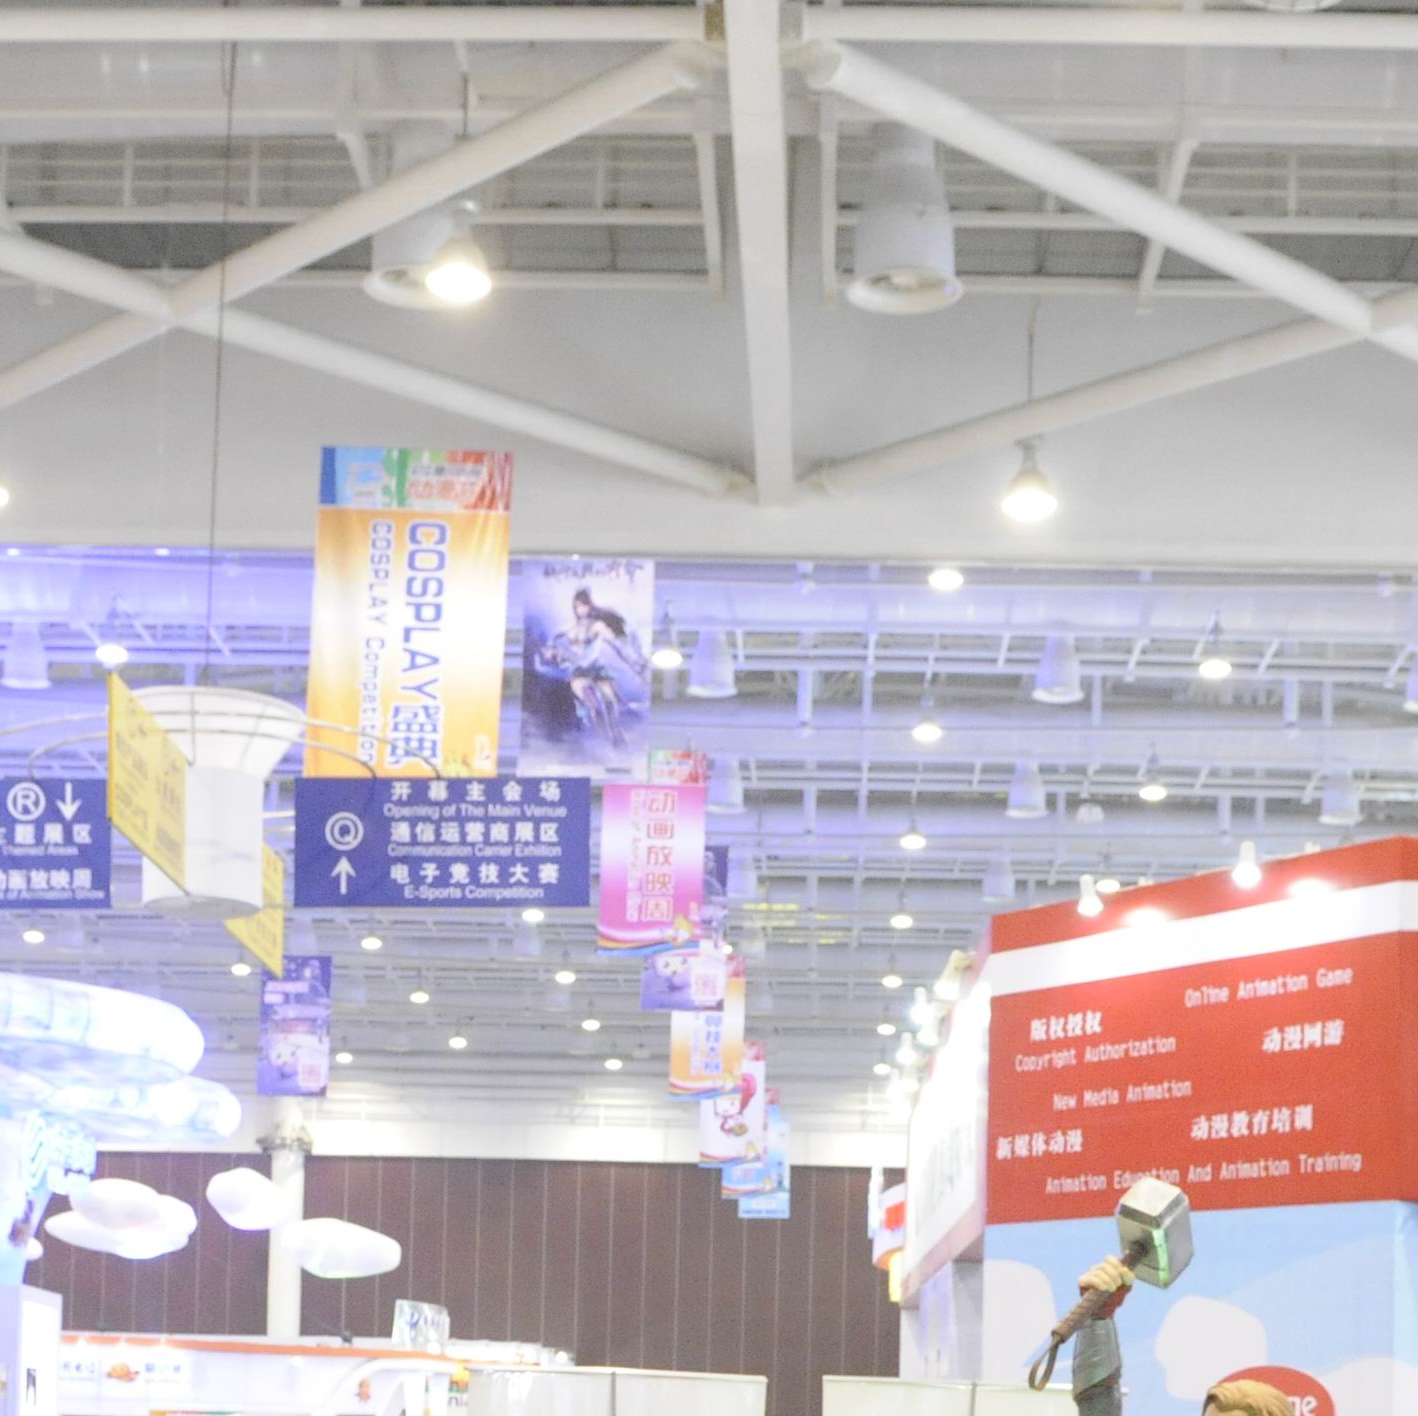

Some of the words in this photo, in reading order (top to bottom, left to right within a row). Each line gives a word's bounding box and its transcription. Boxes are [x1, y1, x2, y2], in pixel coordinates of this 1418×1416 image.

[368, 520, 393, 626] COSPLAY
[390, 780, 561, 802] 开幕主会场
[383, 803, 440, 819] Opening
[442, 803, 458, 817] of
[459, 803, 485, 817] The
[487, 803, 521, 817] Main
[523, 803, 568, 817] Venue
[390, 821, 559, 843] 通信运营商展区
[390, 862, 560, 884] 电子竞技大赛
[404, 885, 462, 900] E-Sports
[464, 885, 545, 901] Competition
[1184, 985, 1230, 1008] Online
[1237, 973, 1308, 1000] Animation
[1316, 967, 1354, 988] Game
[1029, 1009, 1103, 1041] 版权授权
[1015, 1049, 1077, 1073] Copyright
[1084, 1035, 1176, 1063] Authorization
[1053, 1092, 1078, 1111] New
[1083, 1087, 1119, 1108] Media
[1126, 1080, 1193, 1102] Animation
[1190, 1104, 1314, 1141] 动漫教育培训
[995, 1128, 1083, 1160] 新媒体动漫
[1045, 1172, 1107, 1194] Animation
[1188, 1163, 1213, 1184] And
[1219, 1157, 1291, 1180] Animation
[1298, 1151, 1363, 1173] Training
